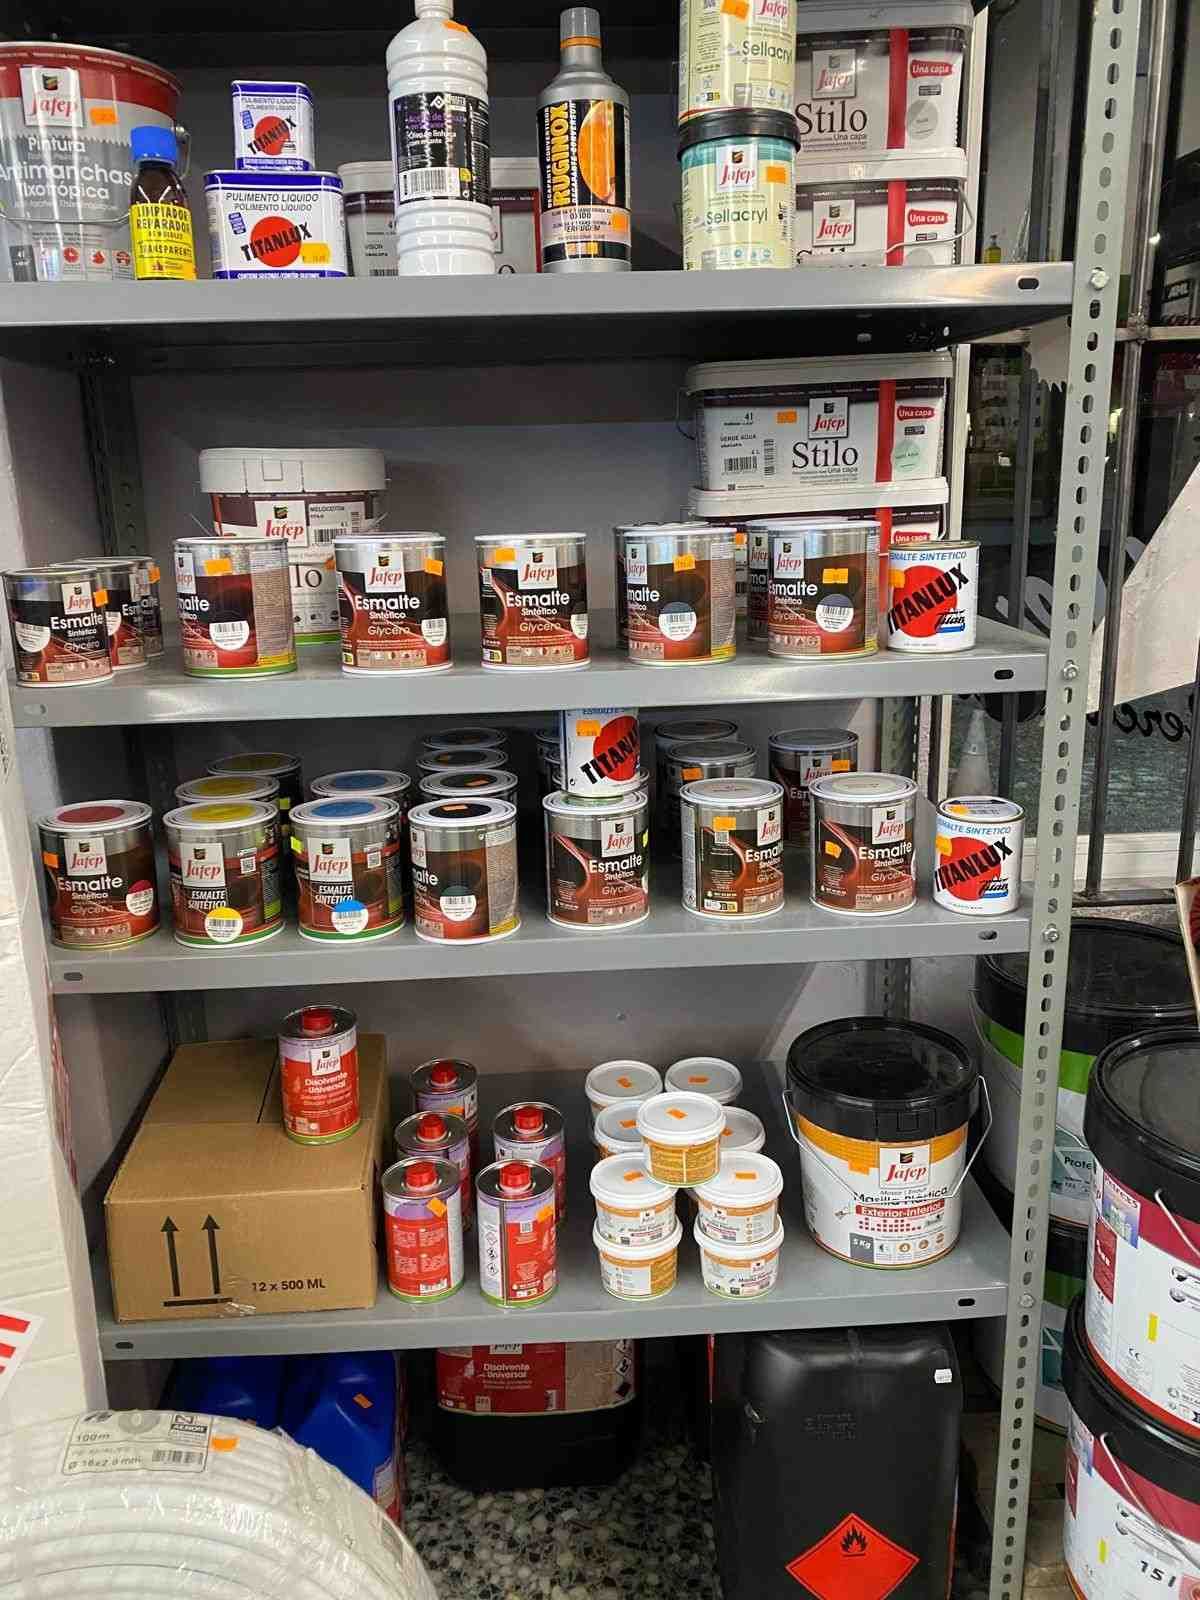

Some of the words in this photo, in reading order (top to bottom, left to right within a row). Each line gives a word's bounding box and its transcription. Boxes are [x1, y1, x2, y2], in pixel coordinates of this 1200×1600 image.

[742, 40, 793, 64] Sellacryl
[794, 100, 867, 136] Stilo
[28, 137, 86, 153] Pintura
[550, 101, 571, 207] RUGINOX
[226, 193, 279, 202] PULIMENTO
[234, 203, 278, 212] POLIMENTO
[706, 207, 768, 225] Sellacryl
[909, 214, 926, 223] Una
[927, 214, 945, 224] capa
[817, 218, 852, 239] Jafep
[240, 223, 312, 266] TITANLUX
[898, 409, 913, 417] Una
[915, 408, 933, 418] capa
[812, 415, 846, 433] Jafep
[792, 440, 859, 469] Stilo
[919, 551, 967, 561] SINTETICO
[368, 567, 402, 586] Jafep
[522, 563, 555, 582] Jafep
[354, 594, 421, 611] Esmalte
[506, 590, 570, 608] Esmalte
[50, 612, 105, 632] Esmalte
[519, 621, 562, 633] Glycero
[367, 625, 411, 638] Glycero
[64, 640, 100, 652] Glycero
[876, 820, 904, 838] Jafep
[966, 825, 1011, 836] SINTETICO
[607, 833, 633, 851] Jafep
[859, 841, 913, 862] Esmalte
[71, 852, 104, 870] Jafep
[185, 859, 221, 880] Jafep
[312, 854, 349, 875] Jafep
[588, 853, 642, 876] Esmalte
[57, 874, 124, 893] Esmalte
[319, 885, 353, 895] ESMALTE
[191, 890, 226, 900] ESMALTE
[885, 1164, 927, 1182] Jafep
[252, 1282, 267, 1293] 12
[269, 1284, 279, 1292] x
[281, 1280, 304, 1292] 500
[306, 1278, 326, 1290] ML
[483, 1363, 530, 1371] Disolvente
[487, 1370, 527, 1379] Universal
